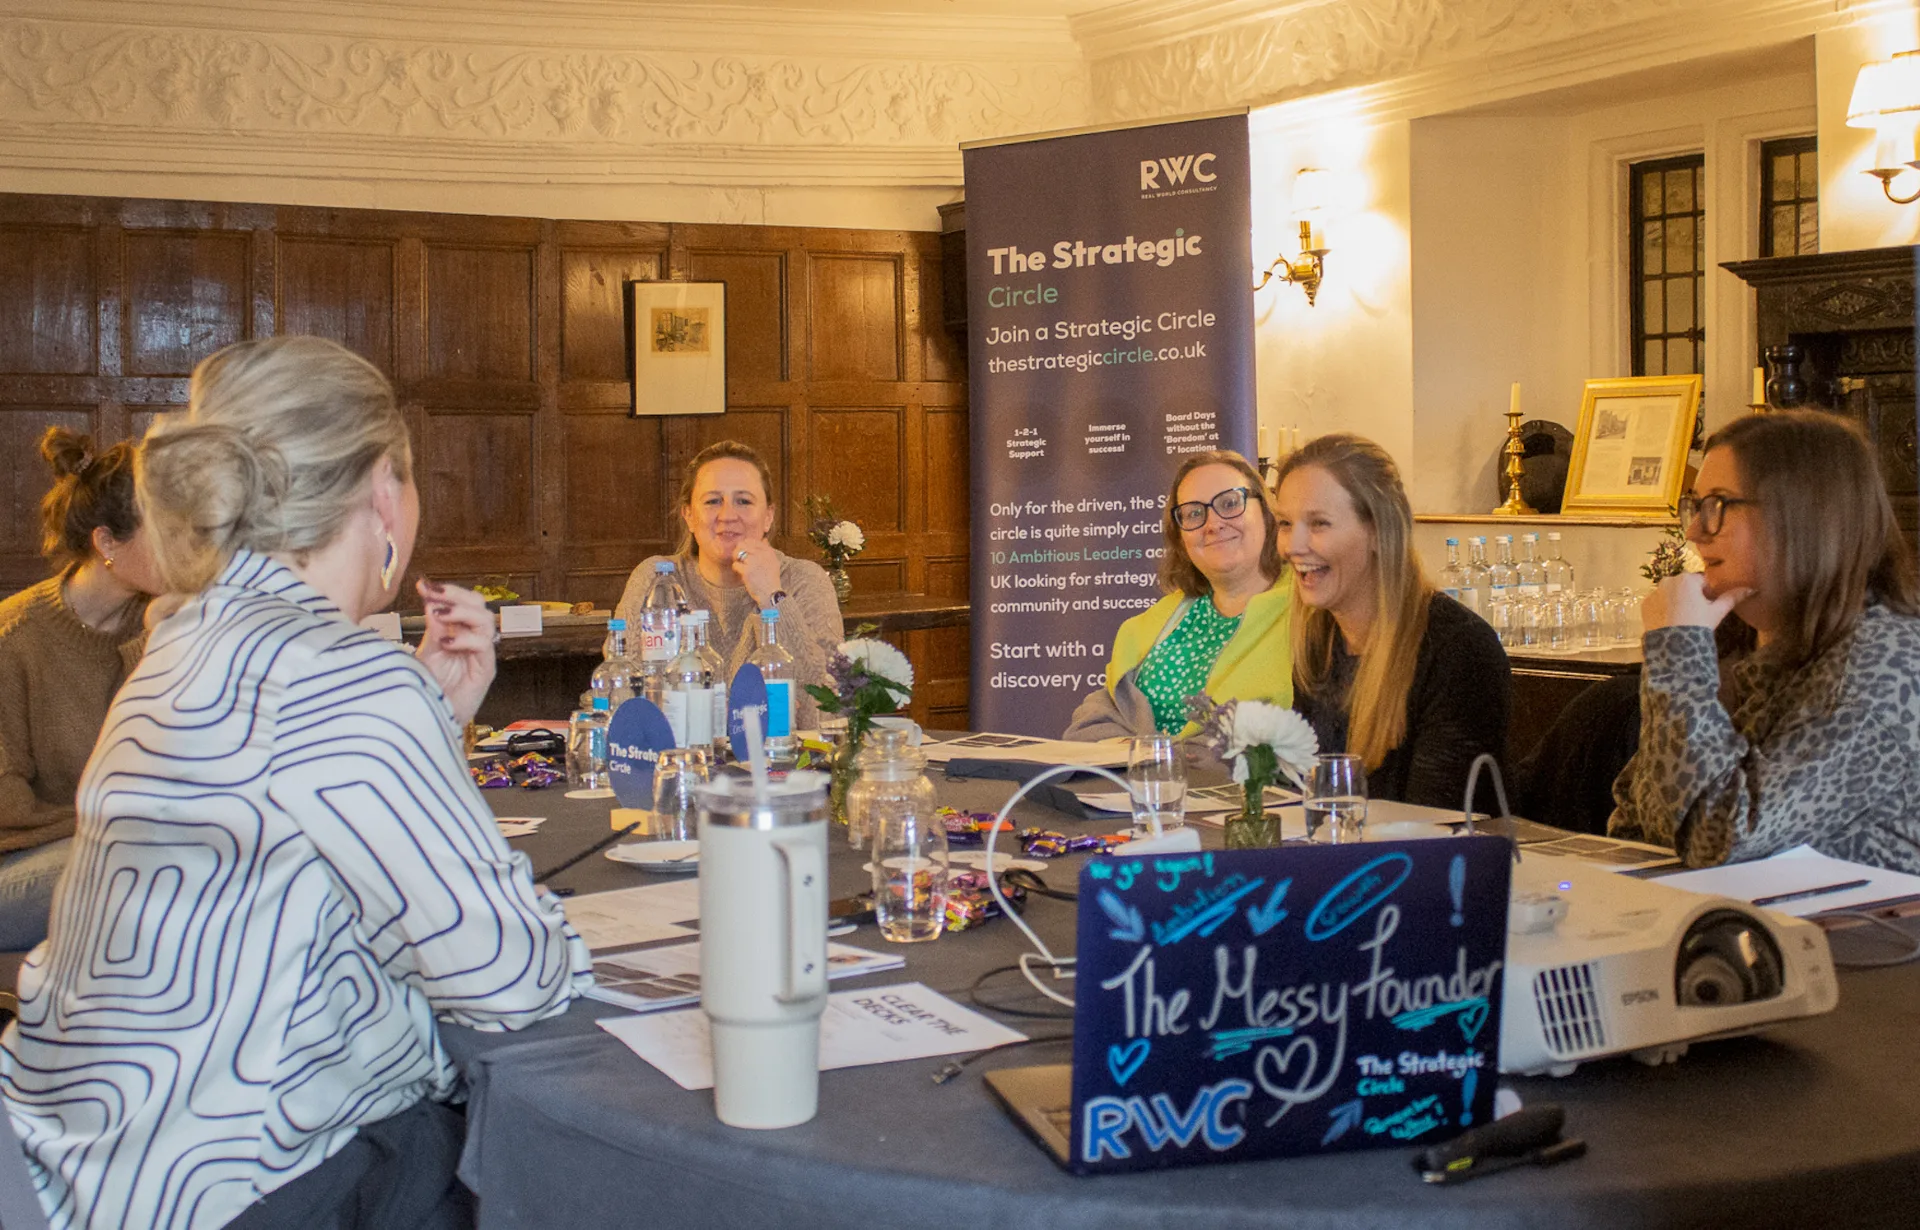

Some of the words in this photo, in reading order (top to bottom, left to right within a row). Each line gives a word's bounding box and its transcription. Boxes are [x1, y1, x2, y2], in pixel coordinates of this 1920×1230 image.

[1140, 152, 1217, 190] RWC
[1177, 186, 1217, 196] CONSULTANCY
[987, 246, 1046, 275] The
[1052, 228, 1202, 269] Strategic
[988, 284, 1059, 308] Circle
[986, 326, 1030, 345] Join
[1035, 326, 1048, 340] a
[1054, 315, 1152, 341] Strategic
[1157, 310, 1216, 331] Circle
[988, 341, 1207, 373] thestrategiccircle.co.uk
[1166, 412, 1192, 422] Board
[1193, 411, 1216, 421] Days
[1014, 428, 1038, 436] 1-2-1
[1088, 424, 1126, 432] Immerse
[1166, 423, 1200, 433] without
[1200, 422, 1216, 430] the
[1209, 432, 1219, 440] at
[1006, 438, 1047, 449] Strategic
[1084, 433, 1121, 445] yourself
[1122, 433, 1131, 441] in
[1009, 449, 1044, 460] Support
[1088, 444, 1125, 454] success!
[1177, 444, 1217, 453] locations
[990, 502, 1022, 519] Only
[1025, 501, 1048, 515] for
[1050, 499, 1075, 514] the
[1077, 498, 1127, 513] driven,
[1130, 496, 1154, 510] the
[990, 526, 1028, 541] circle
[1030, 526, 1042, 539] is
[1044, 524, 1080, 541] quite
[1083, 521, 1129, 538] simply
[1132, 519, 1163, 534] circl
[990, 551, 1006, 565] 10
[1008, 548, 1080, 564] Ambitious
[1083, 546, 1142, 561] Leaders
[990, 575, 1012, 589] UK
[1014, 574, 1066, 590] looking
[1069, 572, 1091, 586] for
[990, 598, 1070, 614] community
[1072, 596, 1100, 611] and
[990, 642, 1041, 659] Start
[1045, 640, 1087, 658] with
[1091, 643, 1104, 656] a
[990, 672, 1082, 691] discovery
[609, 742, 627, 758] The
[627, 745, 658, 763] Strate
[609, 759, 632, 775] Circle
[1102, 944, 1190, 1037] The
[1200, 944, 1348, 1062] Messy
[1352, 904, 1501, 1019] Founder
[1356, 1054, 1394, 1075] The
[1398, 1047, 1484, 1078] Strategic
[1082, 1076, 1254, 1164] RWC
